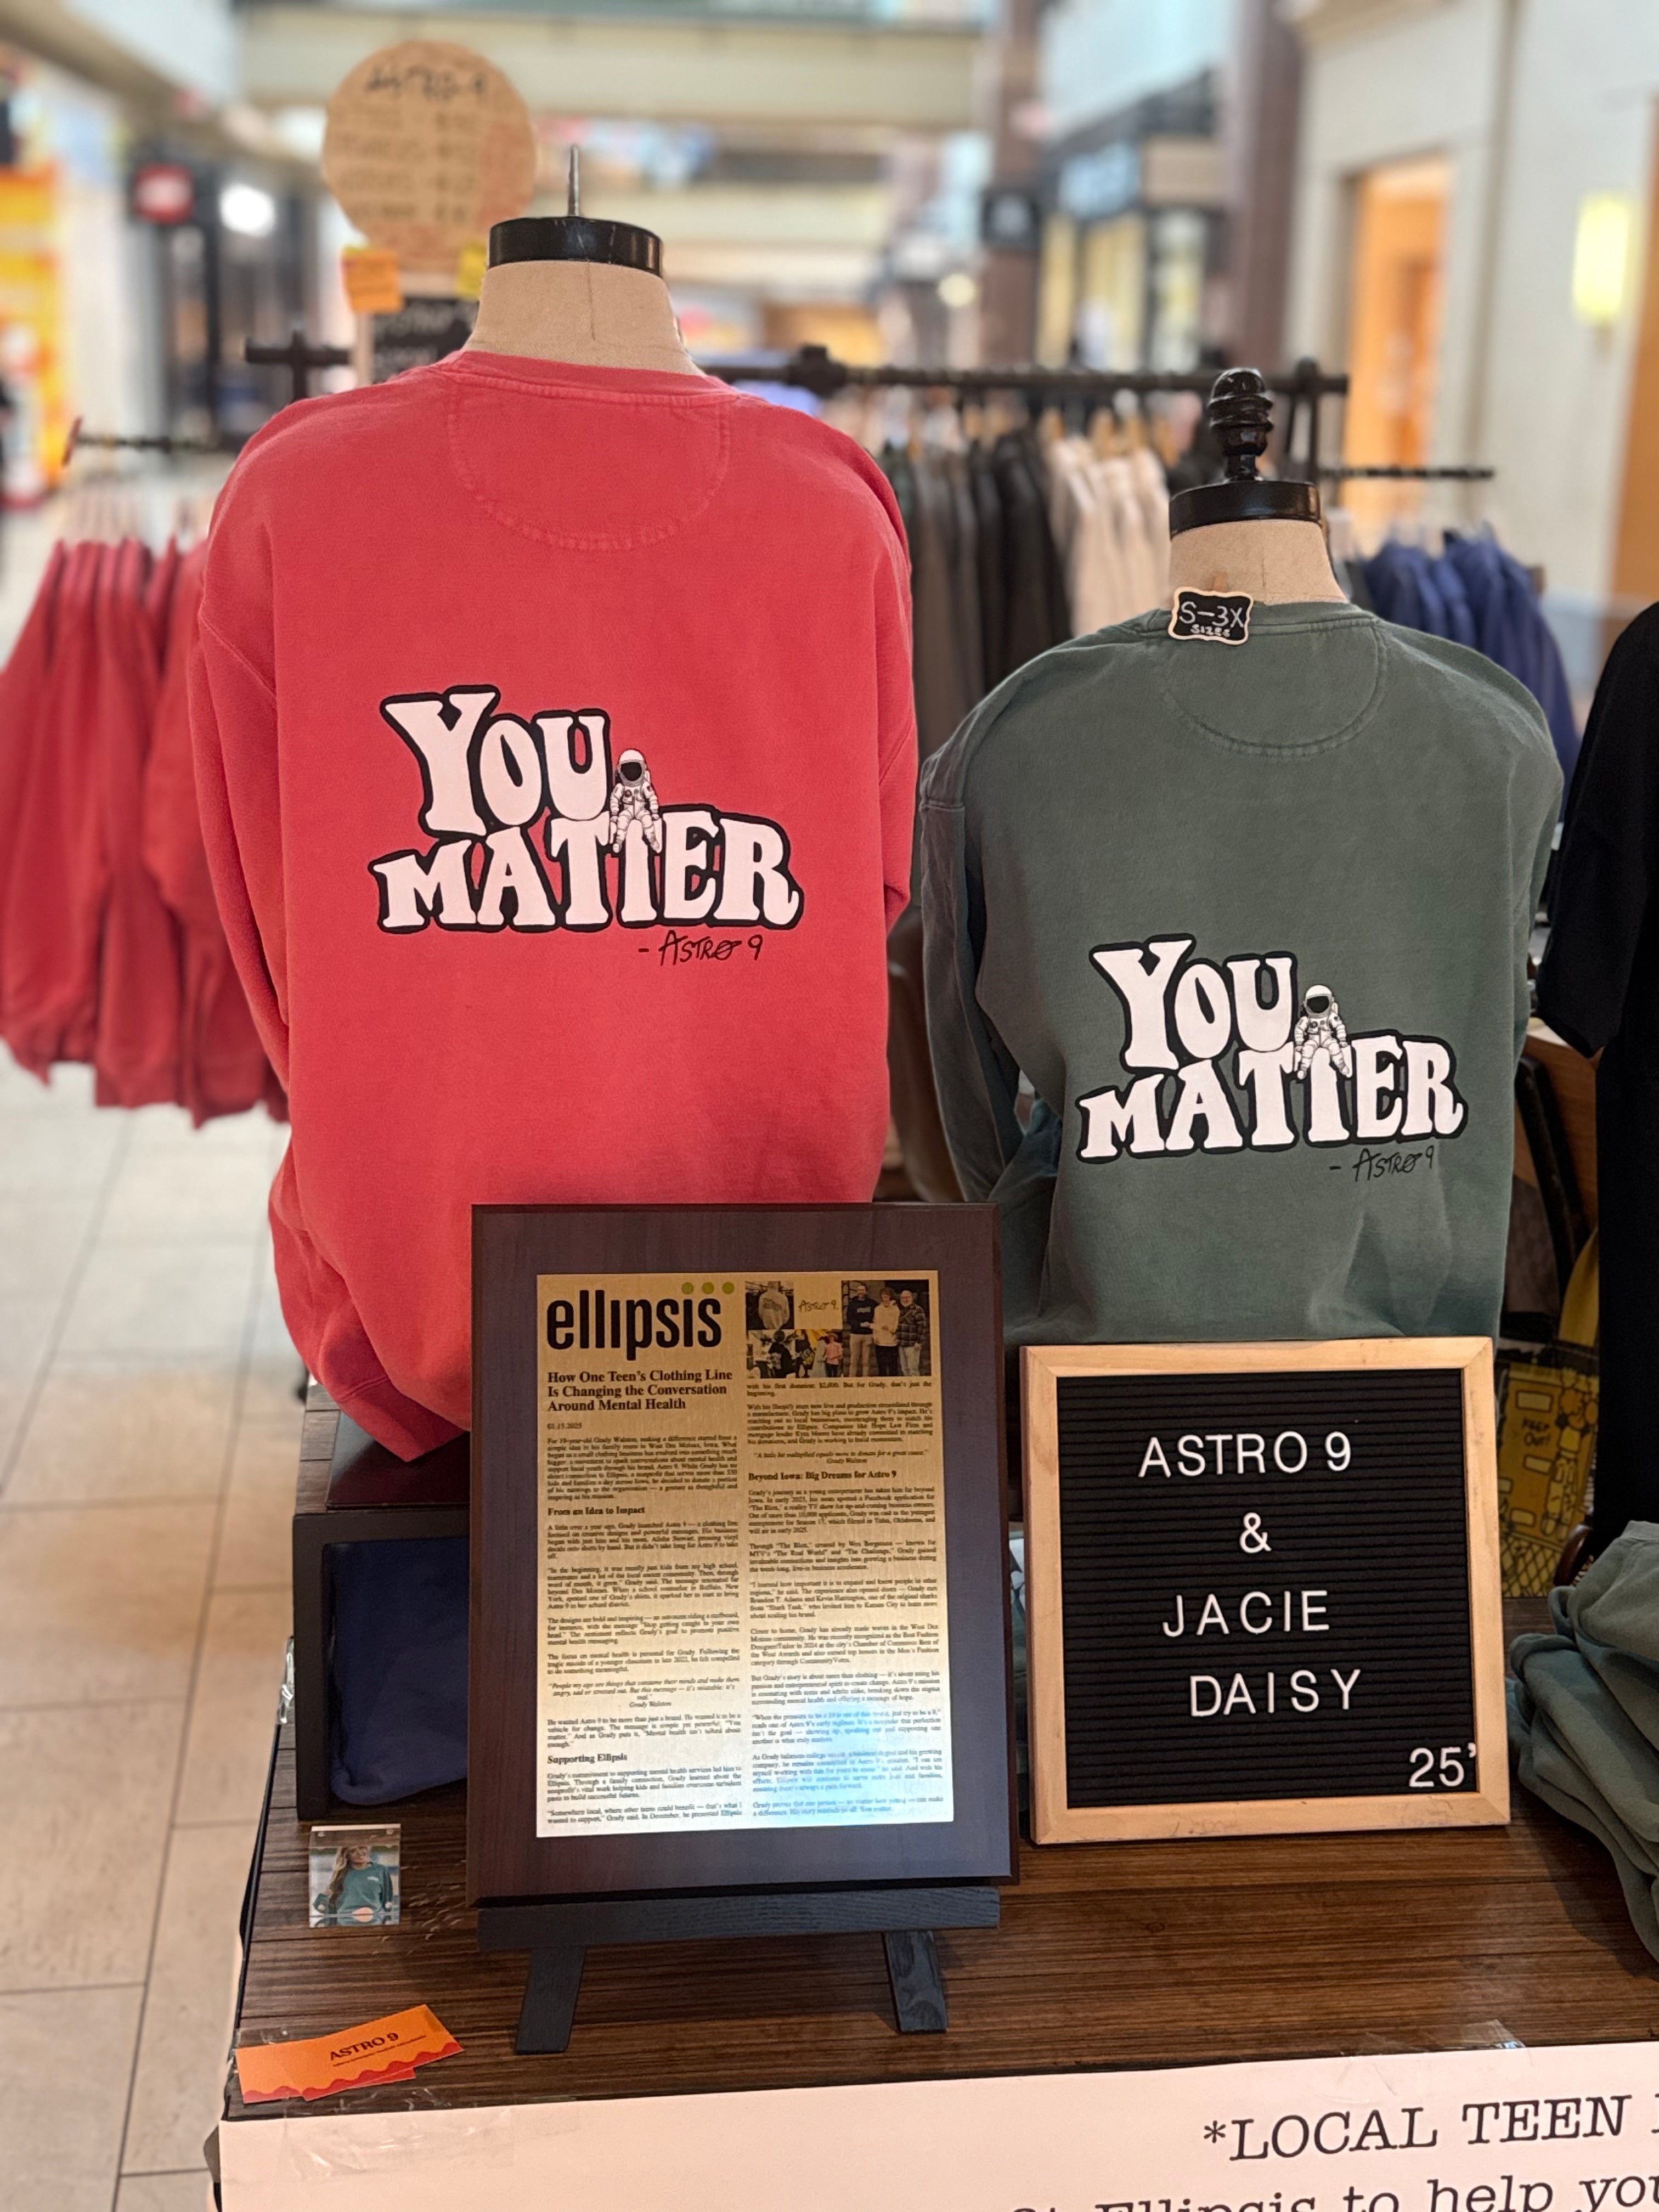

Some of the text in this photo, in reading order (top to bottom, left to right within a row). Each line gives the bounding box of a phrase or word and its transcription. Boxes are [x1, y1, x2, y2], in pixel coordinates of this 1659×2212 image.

[1189, 624, 1231, 637] SIZES
[380, 685, 610, 837] YOU
[368, 804, 804, 934] MATTER
[747, 934, 763, 961] 9
[1088, 933, 1297, 1073] YOU
[1075, 1029, 1469, 1164] MATTER
[1426, 1145, 1435, 1169] 9
[546, 1289, 723, 1361] ellipsis
[547, 1369, 733, 1384] How One Teen's Clothing Line
[547, 1383, 727, 1398] Is Changing the Conversation
[548, 1398, 686, 1411] Around Mental Health
[1138, 1431, 1352, 1478] ASTRO 9
[748, 1473, 778, 1481] Beyond
[616, 1506, 646, 1515] Impact
[1239, 1512, 1272, 1553] &
[1162, 1590, 1330, 1637] JACIE
[1189, 1668, 1361, 1717] DAISY
[547, 1753, 628, 1764] Supporting Ellipsis
[330, 2037, 385, 2061] ASTRO
[386, 2033, 399, 2041] 9
[1462, 2095, 1633, 2145] TEEN
[1342, 2186, 1400, 2212] to
[1427, 2175, 1554, 2212] help
